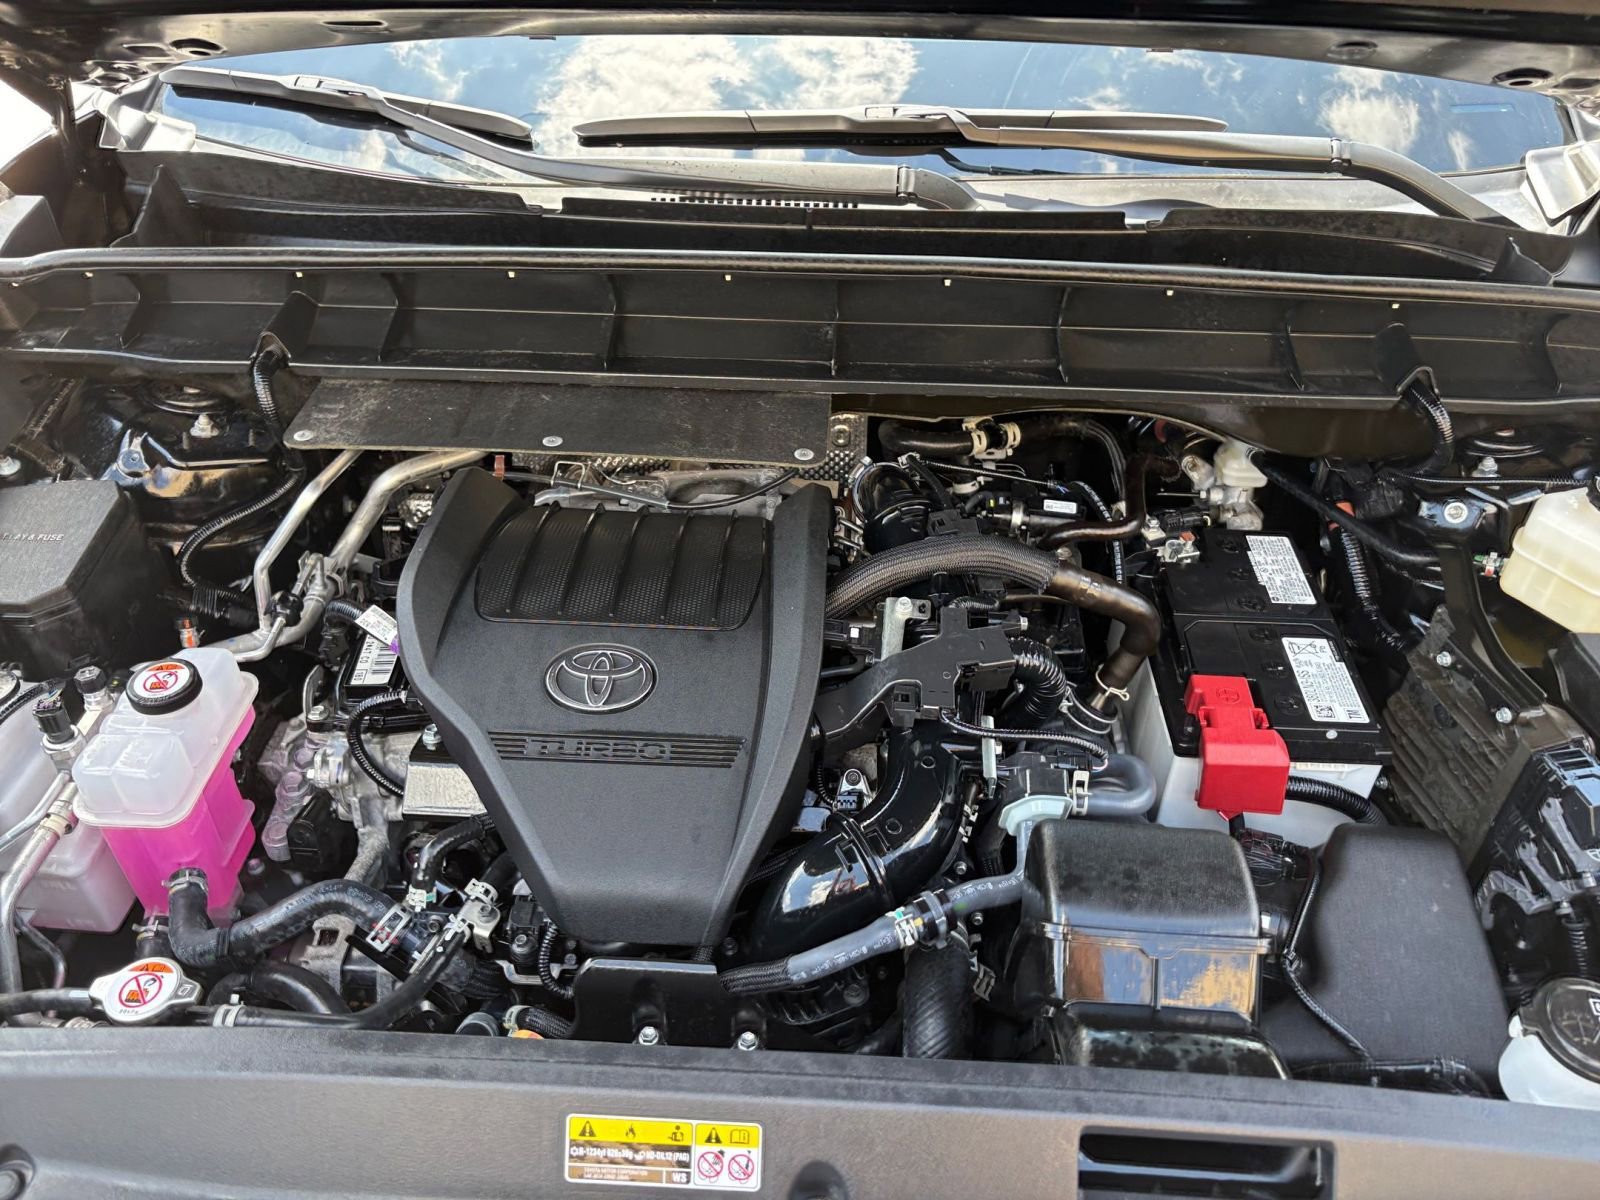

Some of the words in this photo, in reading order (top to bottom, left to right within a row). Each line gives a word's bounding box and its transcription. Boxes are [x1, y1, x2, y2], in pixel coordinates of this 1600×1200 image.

[37, 533, 64, 541] FUSE
[530, 739, 668, 761] TURBO
[674, 1152, 690, 1162] (PAG)
[672, 1172, 687, 1183] WS
